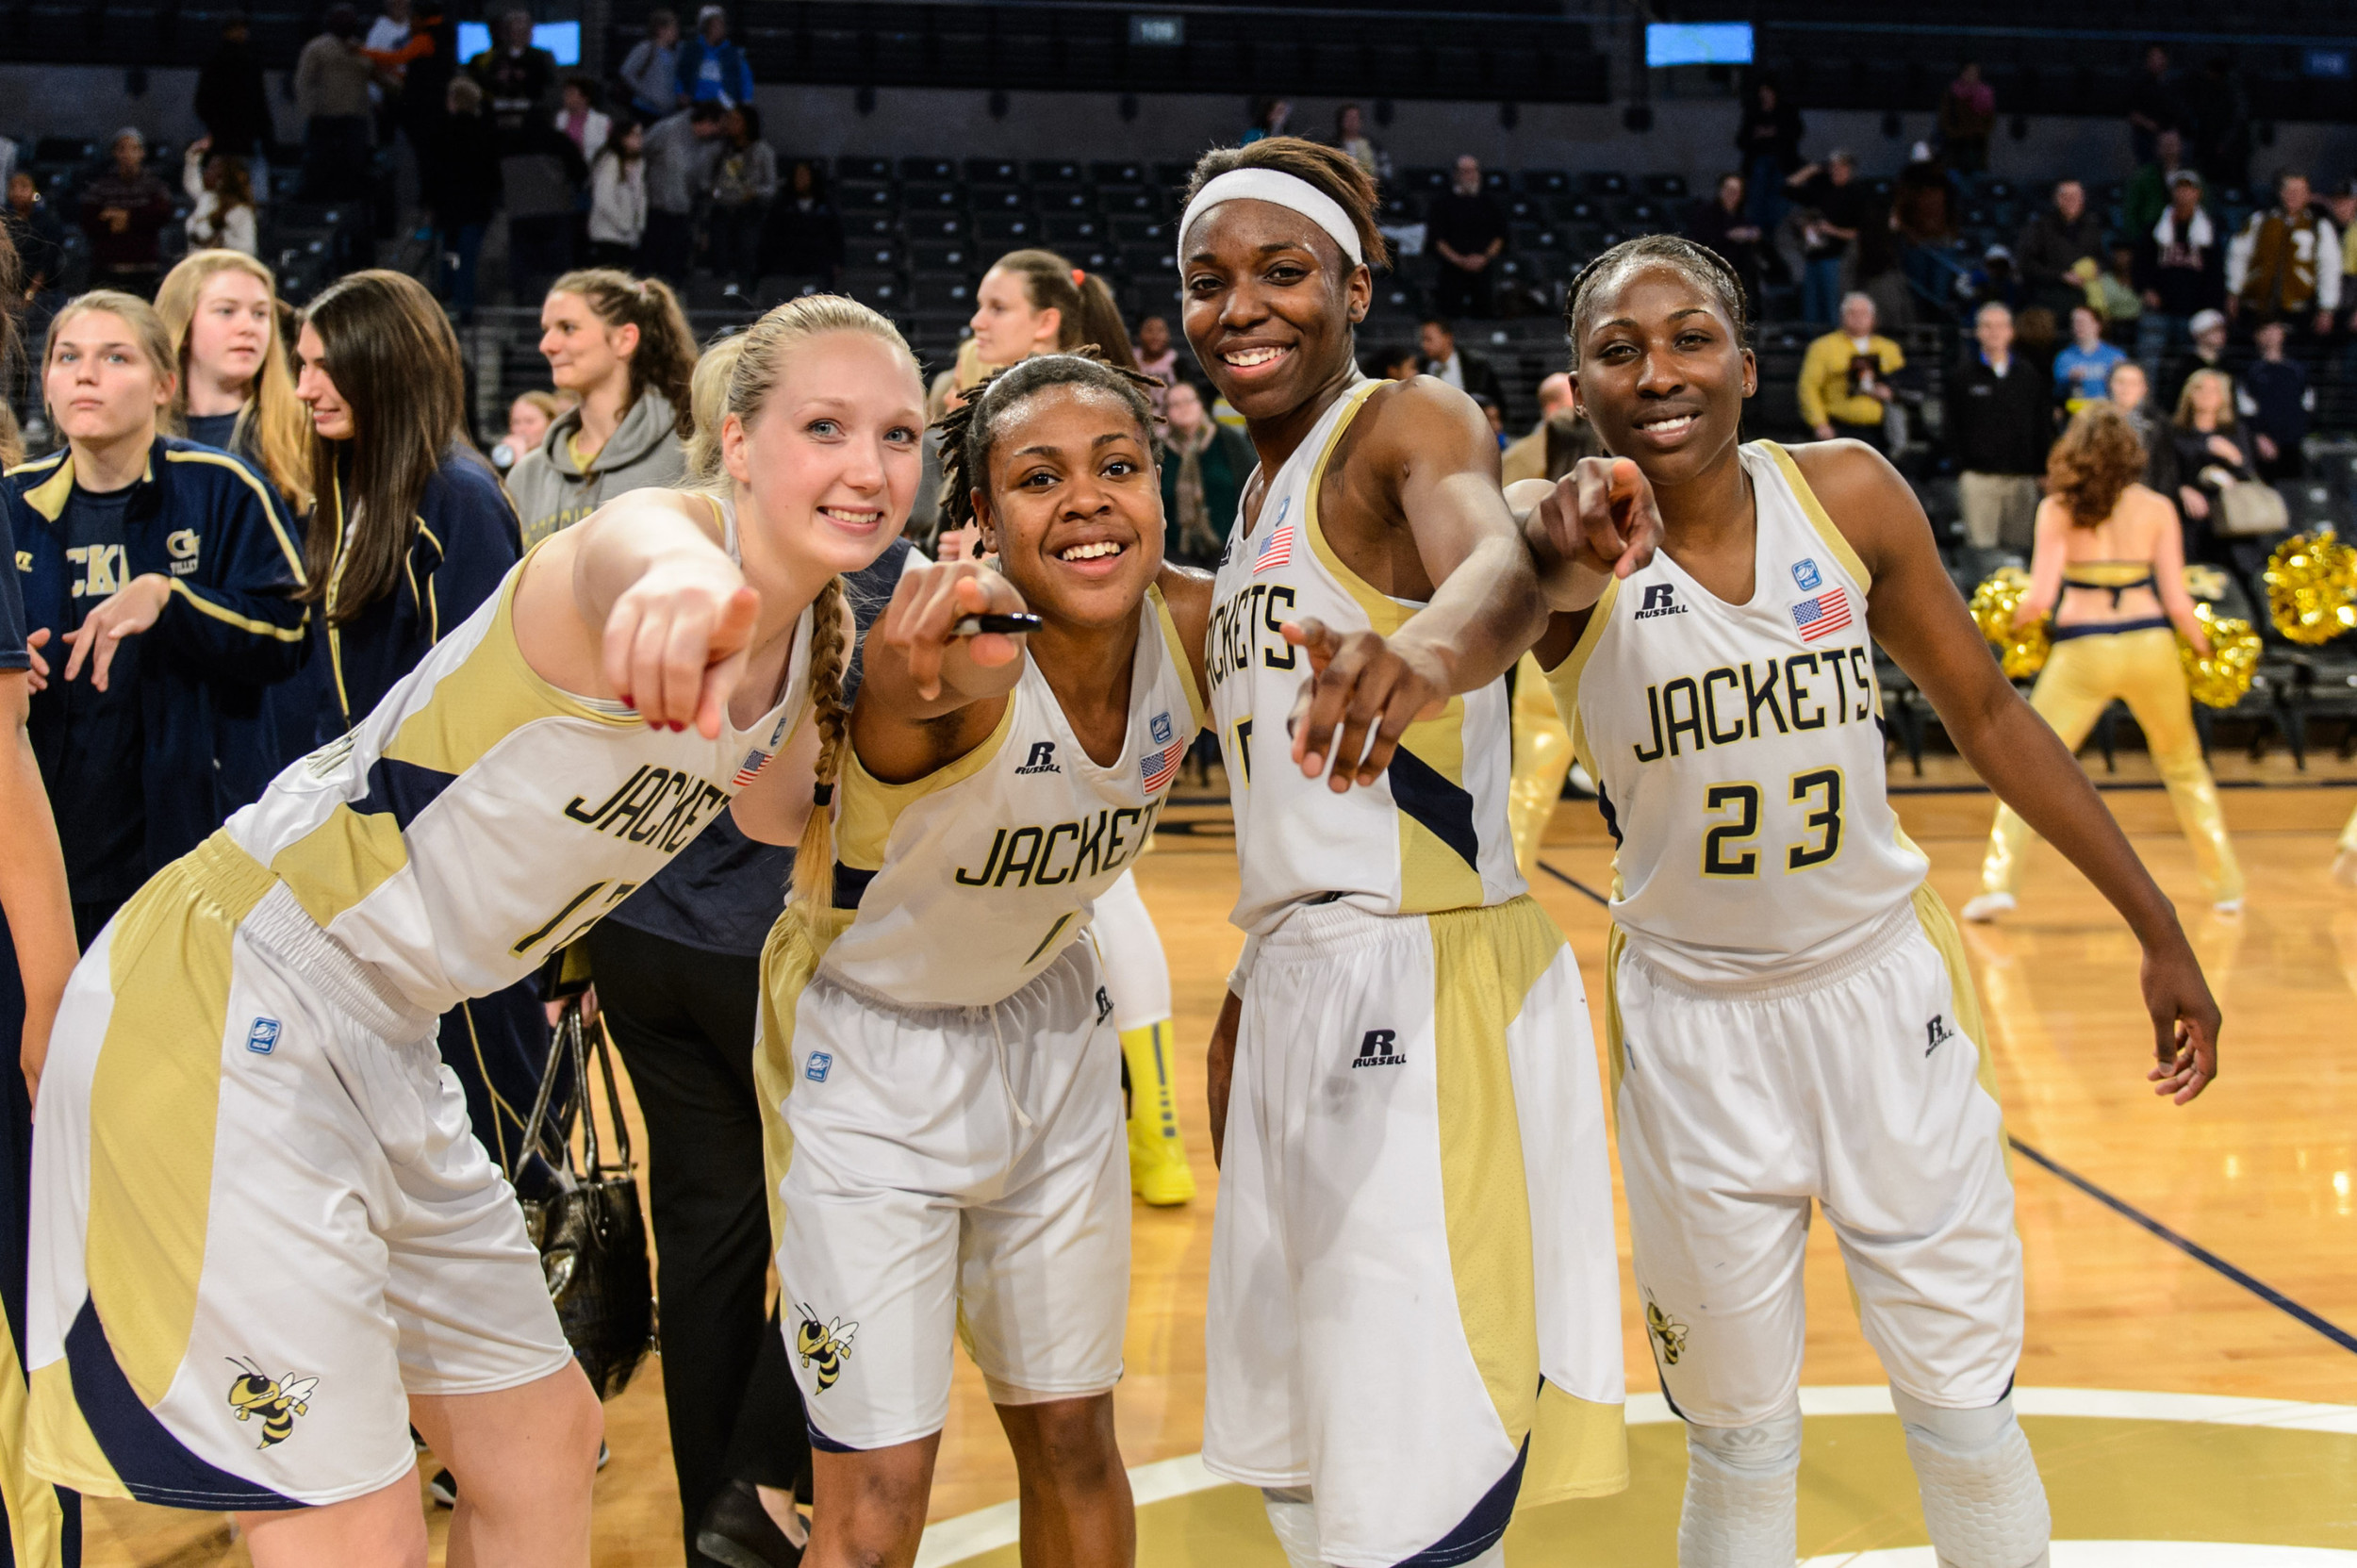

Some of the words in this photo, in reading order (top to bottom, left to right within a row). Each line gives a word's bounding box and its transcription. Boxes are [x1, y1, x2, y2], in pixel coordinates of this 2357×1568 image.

[1634, 604, 1689, 619] RUSSELL
[1633, 645, 1871, 763] JACKETS
[1699, 765, 1846, 880] 23
[1351, 1054, 1407, 1068] RUSSELL
